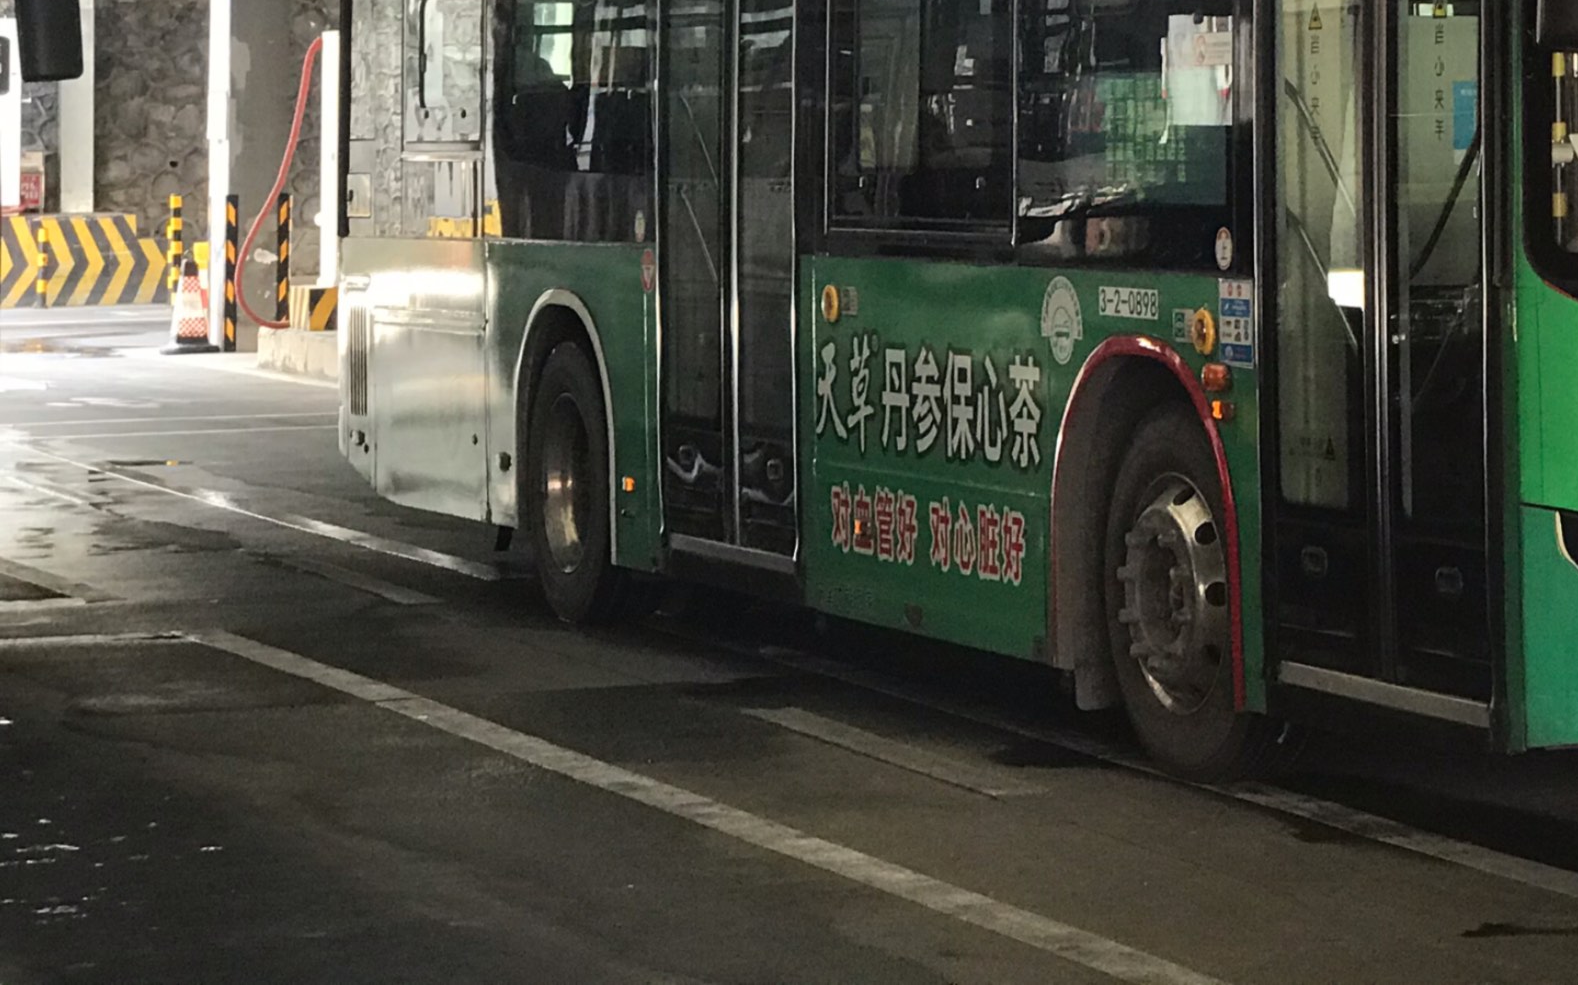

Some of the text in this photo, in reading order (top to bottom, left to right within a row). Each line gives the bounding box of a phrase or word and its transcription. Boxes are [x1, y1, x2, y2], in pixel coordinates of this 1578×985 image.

[1100, 287, 1158, 317] 3-2-0898
[830, 480, 1026, 586] 对血管好 对心脏好
